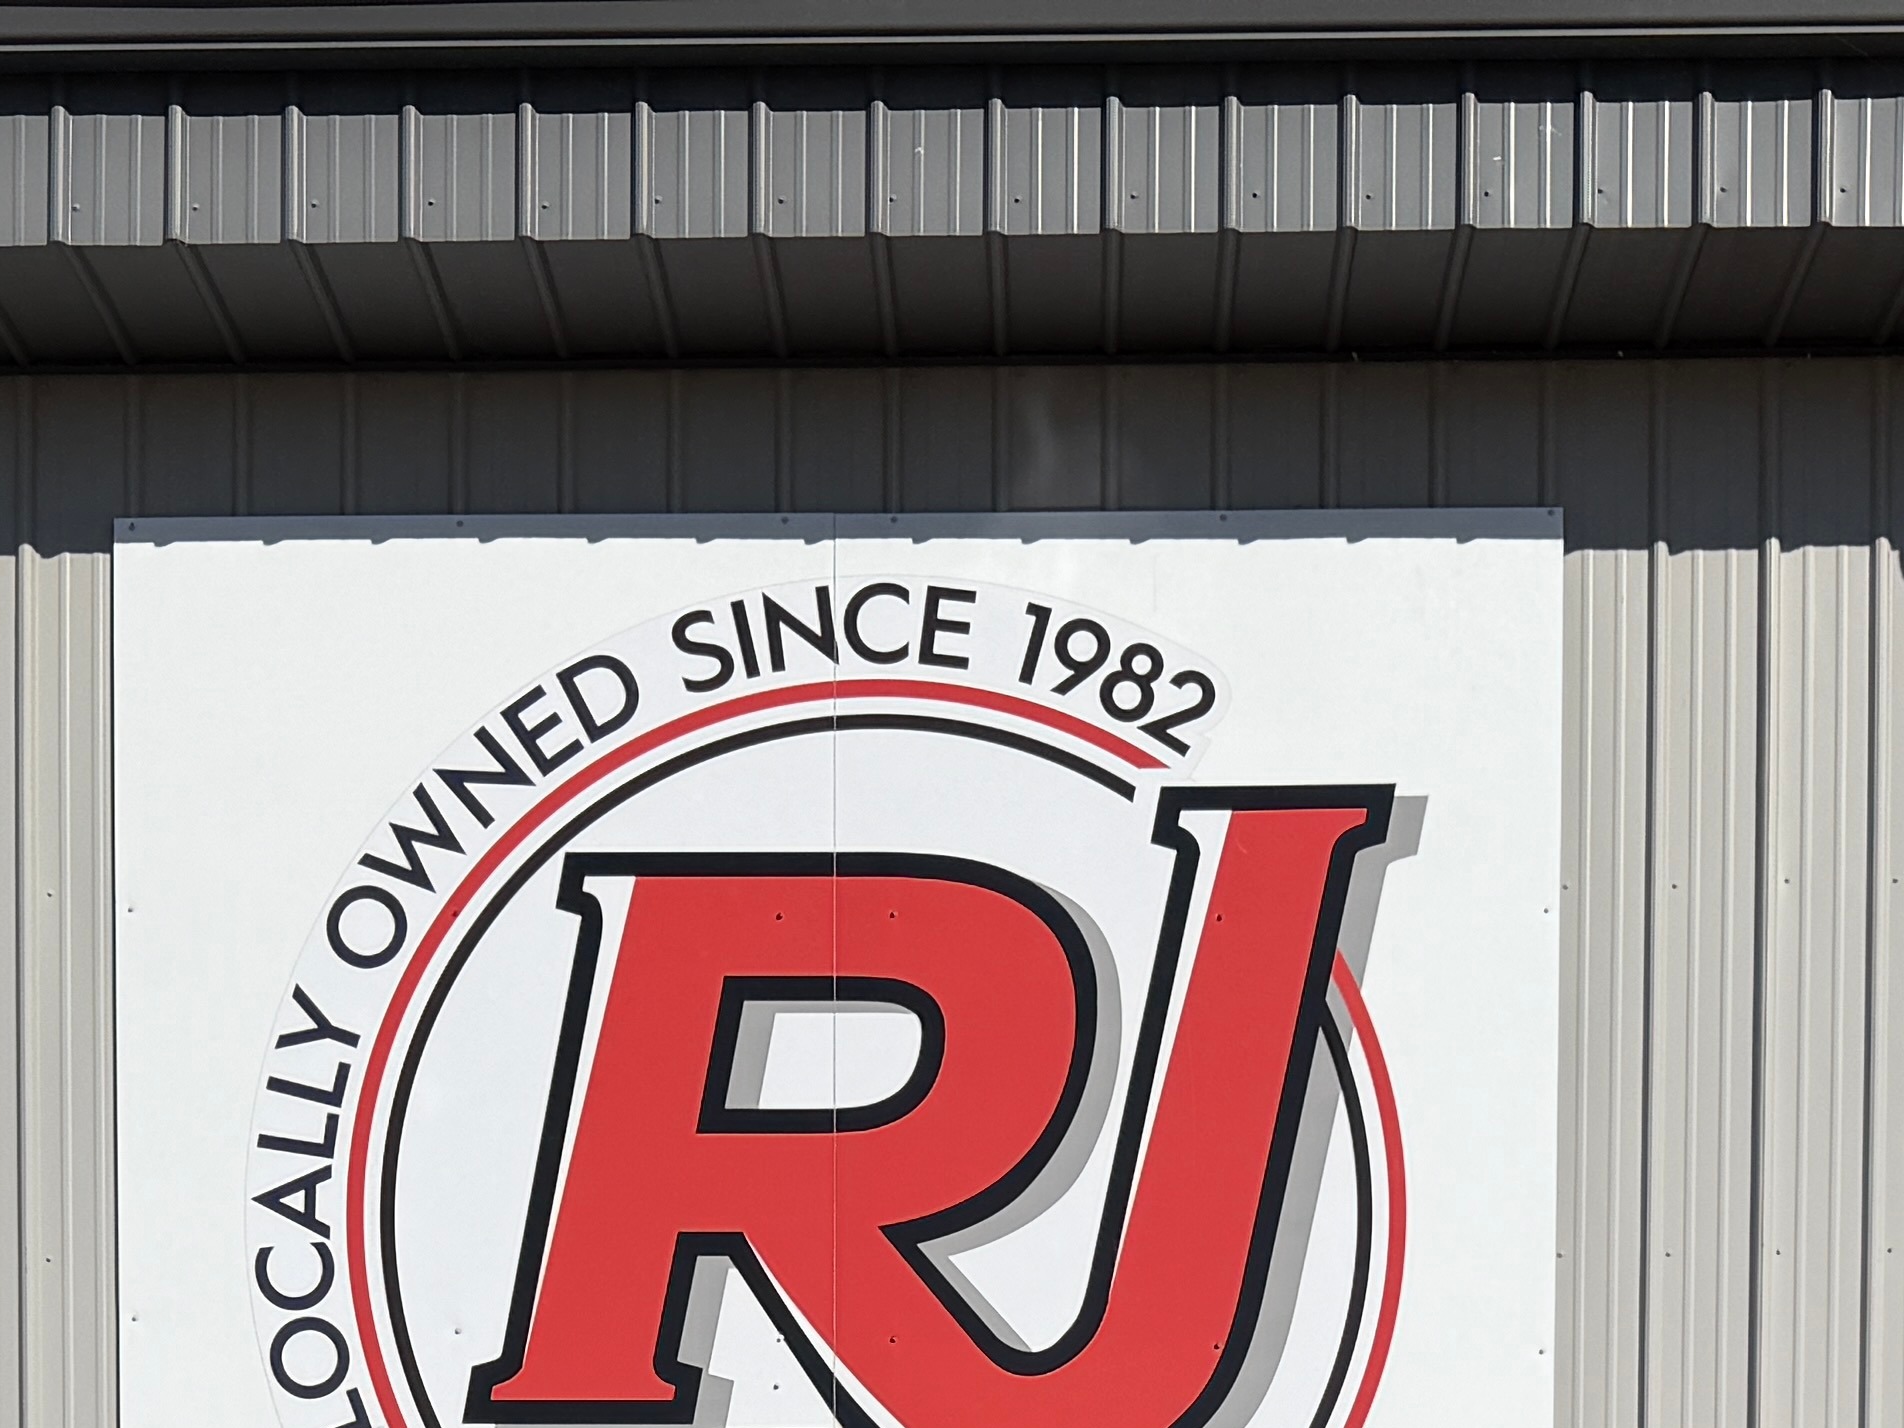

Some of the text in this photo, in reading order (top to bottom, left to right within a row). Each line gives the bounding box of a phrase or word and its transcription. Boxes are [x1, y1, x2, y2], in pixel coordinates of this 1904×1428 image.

[326, 654, 640, 969] OWNED
[671, 582, 977, 693] SINCE
[1018, 601, 1216, 757] 1982
